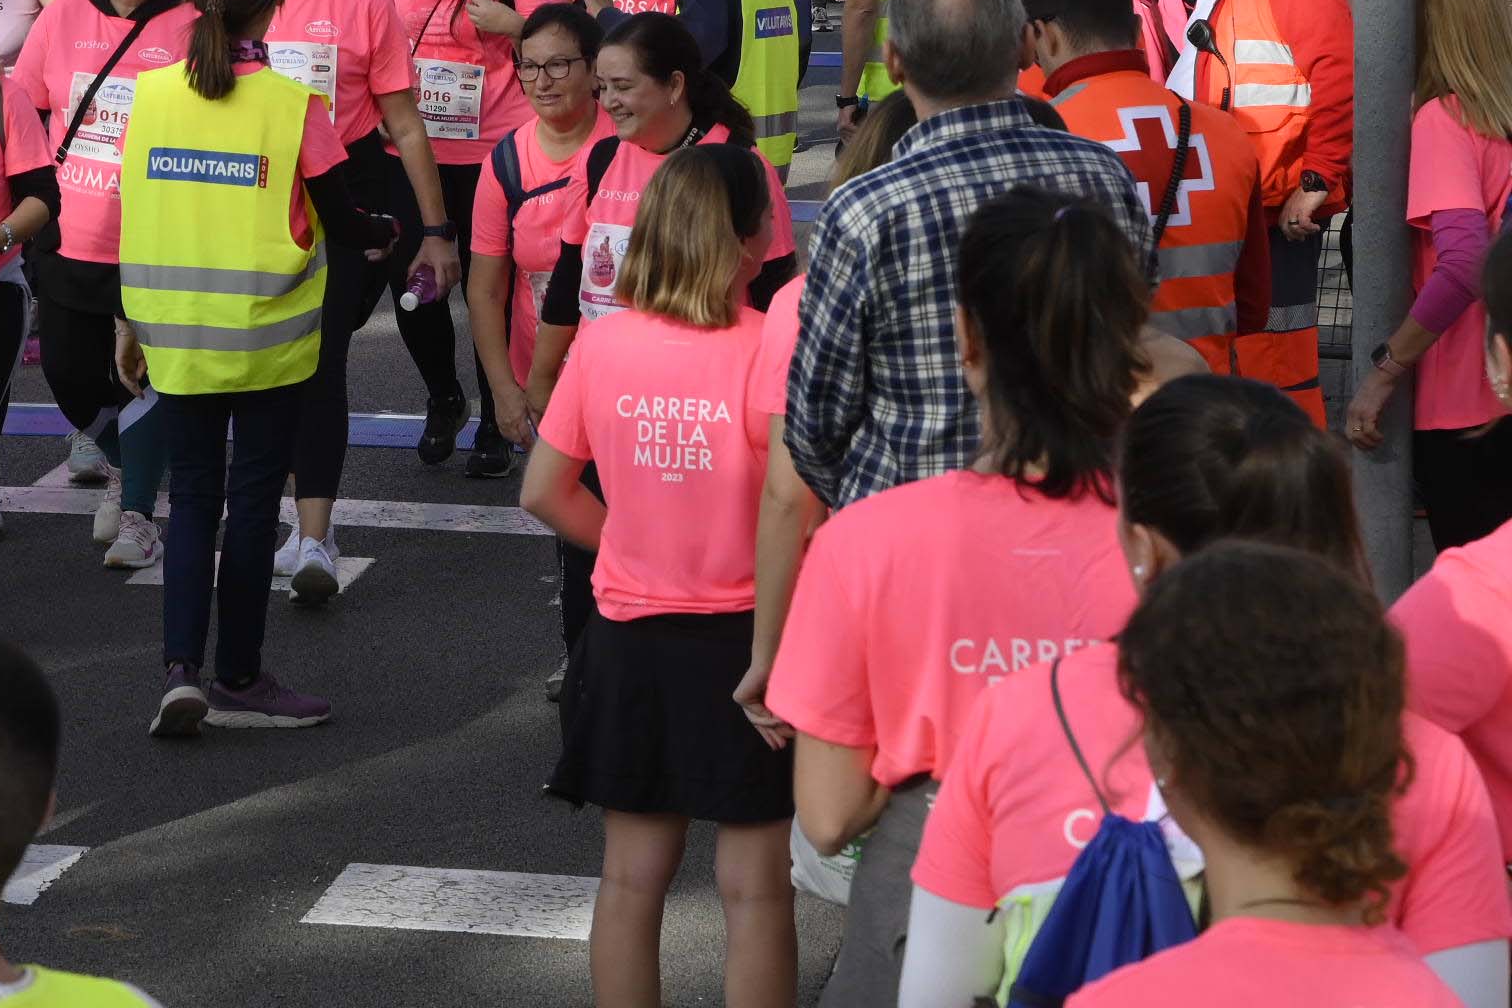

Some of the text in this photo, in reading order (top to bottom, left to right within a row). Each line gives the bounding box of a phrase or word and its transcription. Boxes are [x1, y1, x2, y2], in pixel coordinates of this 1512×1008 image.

[74, 40, 110, 51] OYSHO
[423, 89, 451, 104] 016
[100, 110, 128, 124] 016
[77, 132, 100, 141] CARRERA
[150, 156, 256, 180] VOLUNTARIS
[61, 162, 120, 191] SUMA
[598, 189, 640, 201] OYSHO
[616, 394, 732, 423] CARRERA
[637, 420, 709, 446] DE LA
[633, 444, 713, 471] MUJER
[661, 472, 684, 482] 2023
